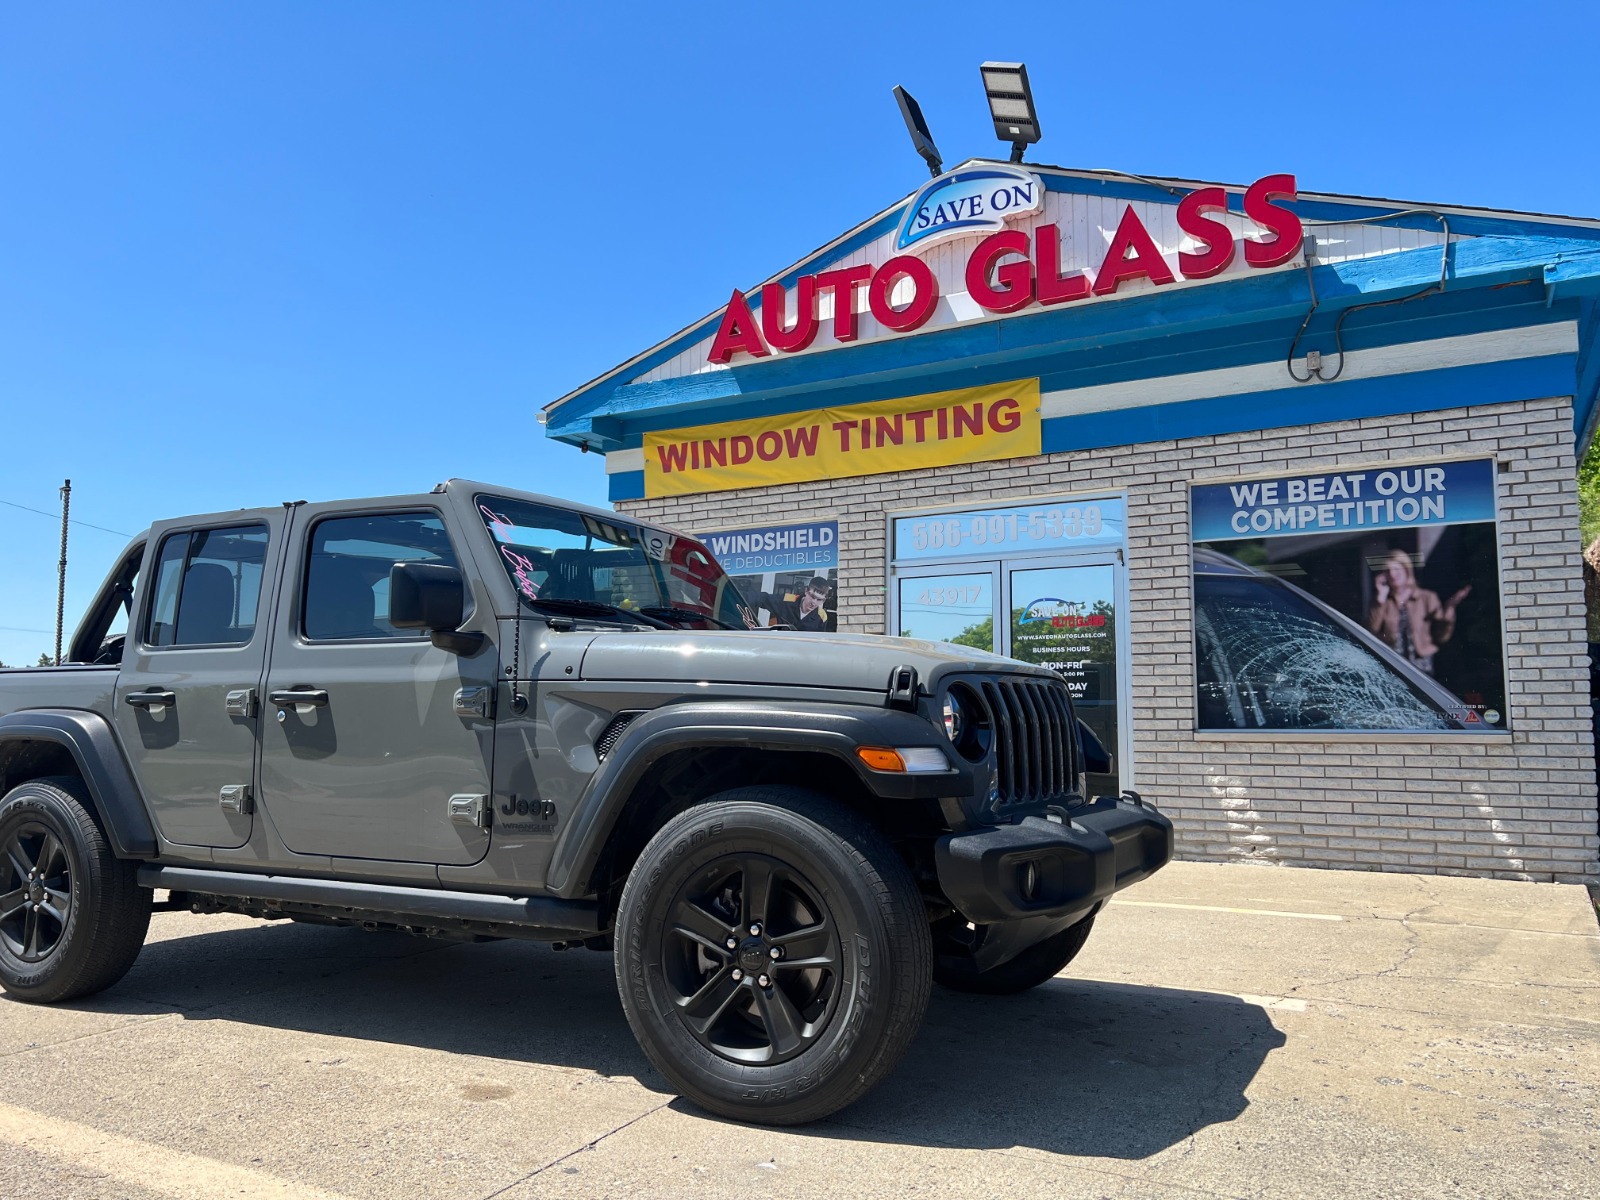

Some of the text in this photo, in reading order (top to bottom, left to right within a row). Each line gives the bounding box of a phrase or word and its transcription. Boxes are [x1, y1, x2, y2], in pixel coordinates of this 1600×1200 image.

[916, 181, 1036, 231] SAVE ON
[706, 173, 1304, 365] AUTO GLASS
[656, 397, 1022, 475] WINDOW TINTING
[1229, 467, 1447, 509] WE BEAT OUR
[912, 505, 1102, 551] 586-991-5339
[1230, 494, 1446, 534] COMPETITION
[711, 527, 834, 556] WINDSHIELD
[735, 550, 831, 569] DEDUCTIBLES
[919, 585, 982, 606] 43917
[1031, 604, 1077, 618] SAVE ON
[1017, 632, 1107, 640] WWW.SAVEONAUTOGLASS.COM
[1032, 645, 1091, 654] BUSINESS HOURS
[1436, 712, 1461, 720] LYNX
[501, 793, 556, 821] Jeep
[628, 821, 725, 1011] BRIDGESTONE
[795, 932, 872, 1093] DUELER
